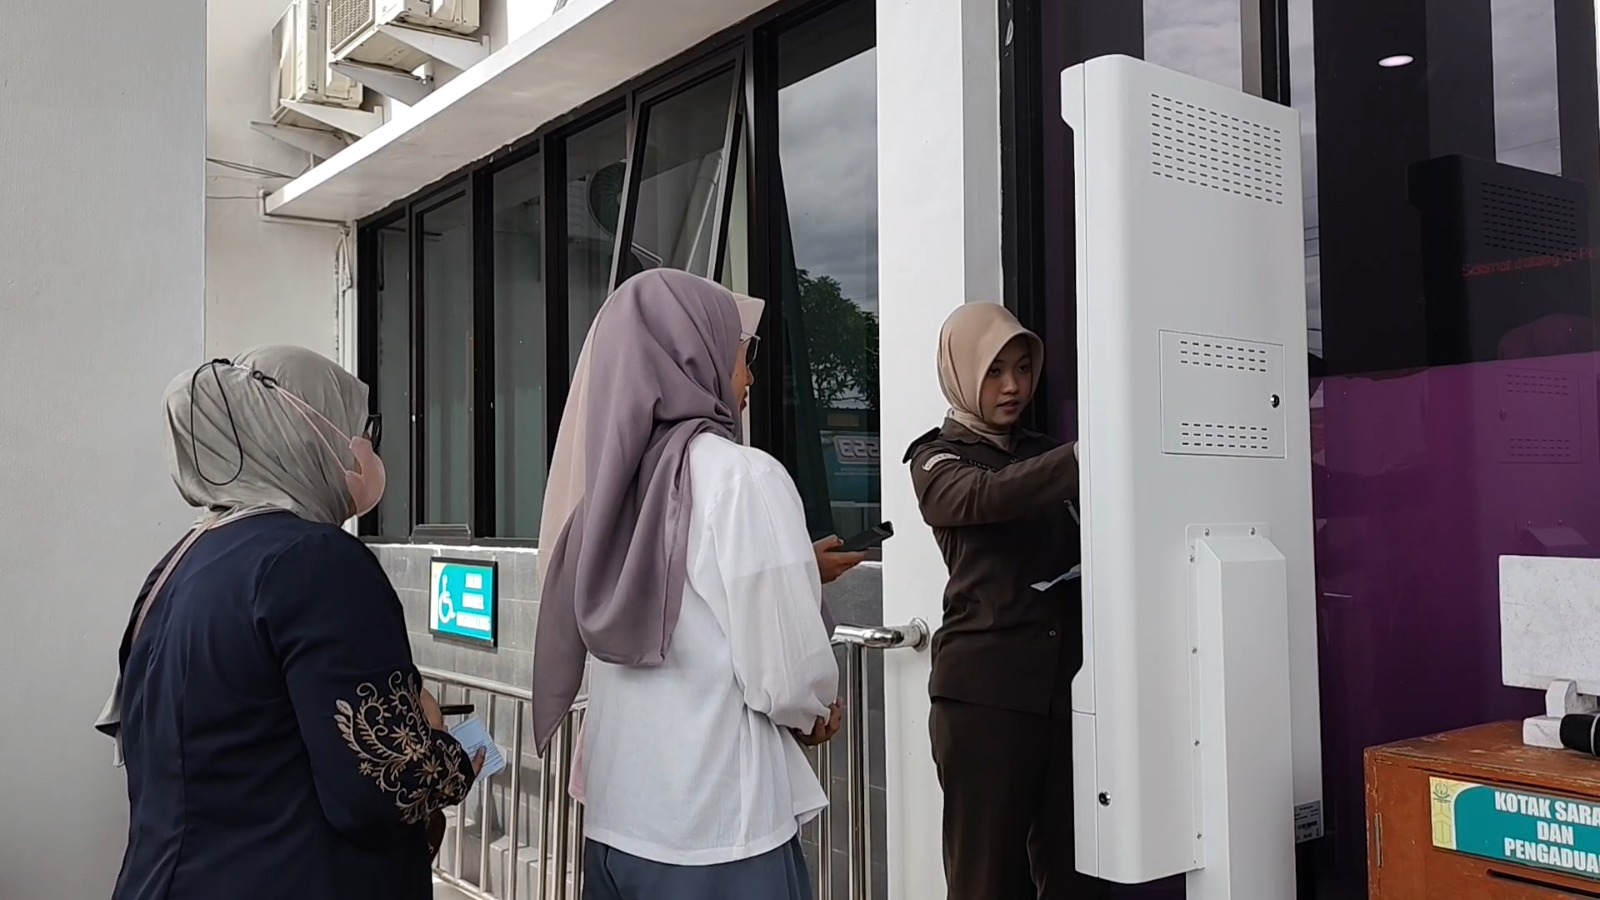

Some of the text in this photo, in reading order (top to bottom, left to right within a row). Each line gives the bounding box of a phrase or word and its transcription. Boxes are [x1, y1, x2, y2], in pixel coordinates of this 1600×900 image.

[1494, 790, 1552, 818] KOTAK
[1536, 820, 1574, 846] DAN
[1504, 837, 1600, 874] PENGADUA
